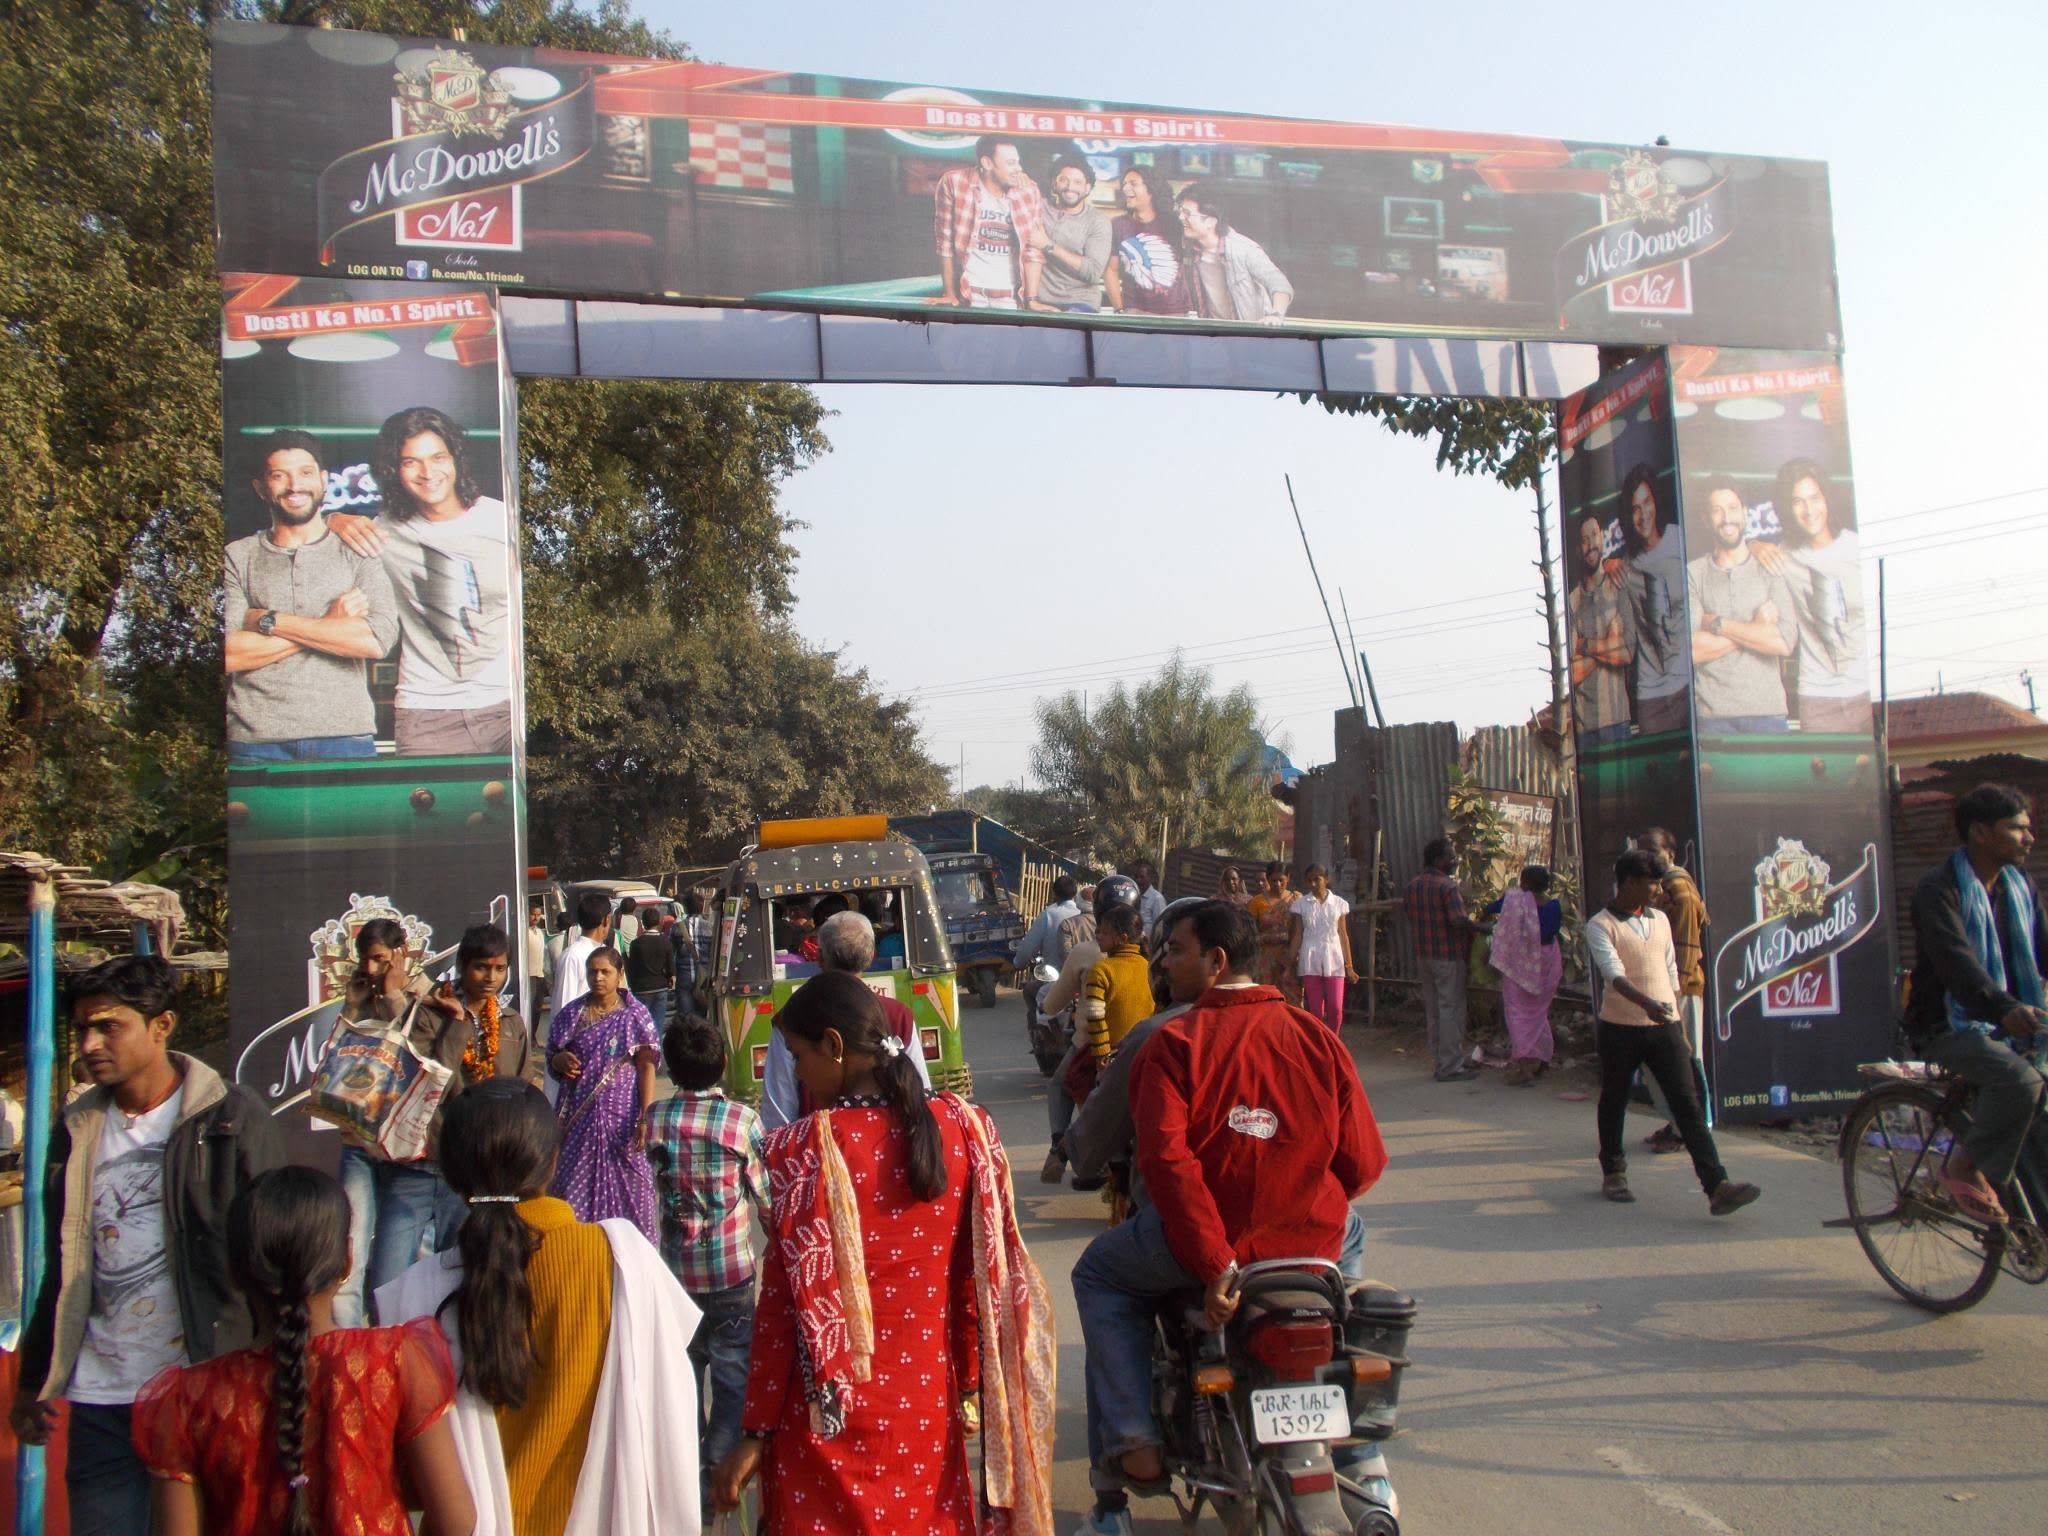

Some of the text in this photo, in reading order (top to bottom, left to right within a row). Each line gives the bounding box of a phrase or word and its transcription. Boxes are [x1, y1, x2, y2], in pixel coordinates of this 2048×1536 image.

[926, 107, 1225, 139] Dosti Ka No.1 Spirit.
[349, 115, 562, 213] McDowell's
[417, 200, 500, 240] No.1
[976, 241, 1009, 254] BUIL
[1576, 203, 1715, 286] McDowell's
[347, 264, 369, 276] LOG
[371, 265, 388, 276] ON
[390, 266, 404, 277] TO
[1621, 274, 1676, 306] No.1
[244, 299, 482, 333] Dosti Ka No.1 Spirit.
[774, 875, 898, 895] WELCOME
[1735, 891, 1858, 991] McDowell's
[1775, 971, 1823, 1007] No.1
[1724, 1096, 1741, 1107] LOG
[1743, 1095, 1756, 1105] ON
[1758, 1094, 1769, 1104] TO
[1791, 1090, 1866, 1103] fb.com/No.1friend
[1272, 1413, 1327, 1436] 1392
